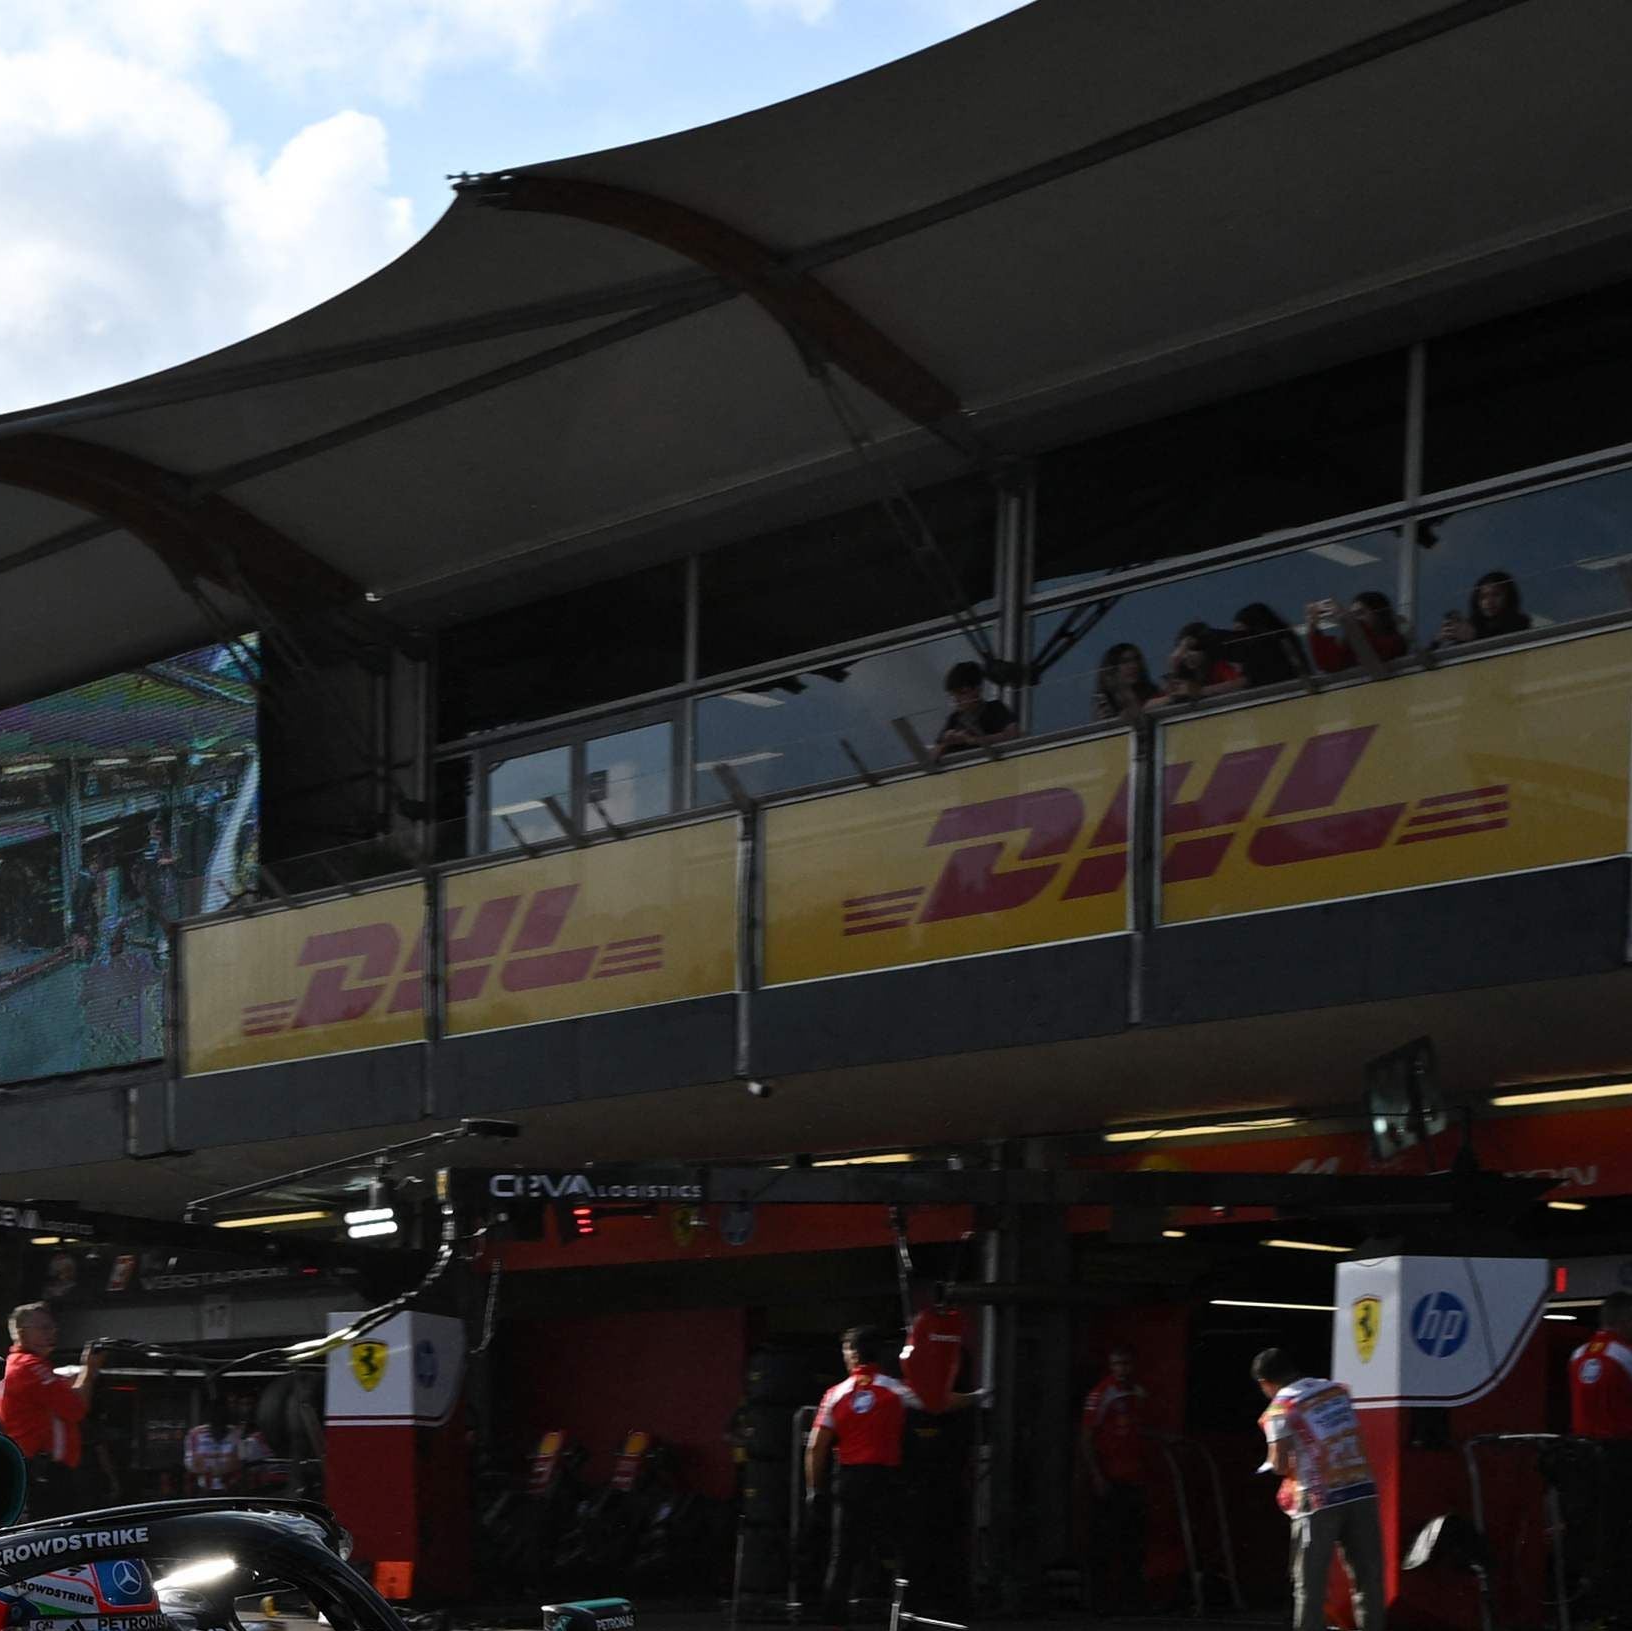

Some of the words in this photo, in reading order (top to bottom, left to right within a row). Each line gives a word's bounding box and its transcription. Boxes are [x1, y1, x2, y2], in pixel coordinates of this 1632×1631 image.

[918, 725, 1407, 924] DHL
[292, 884, 600, 1029] DHL
[598, 1183, 704, 1199] LOGISTICS
[1417, 1291, 1464, 1358] hp
